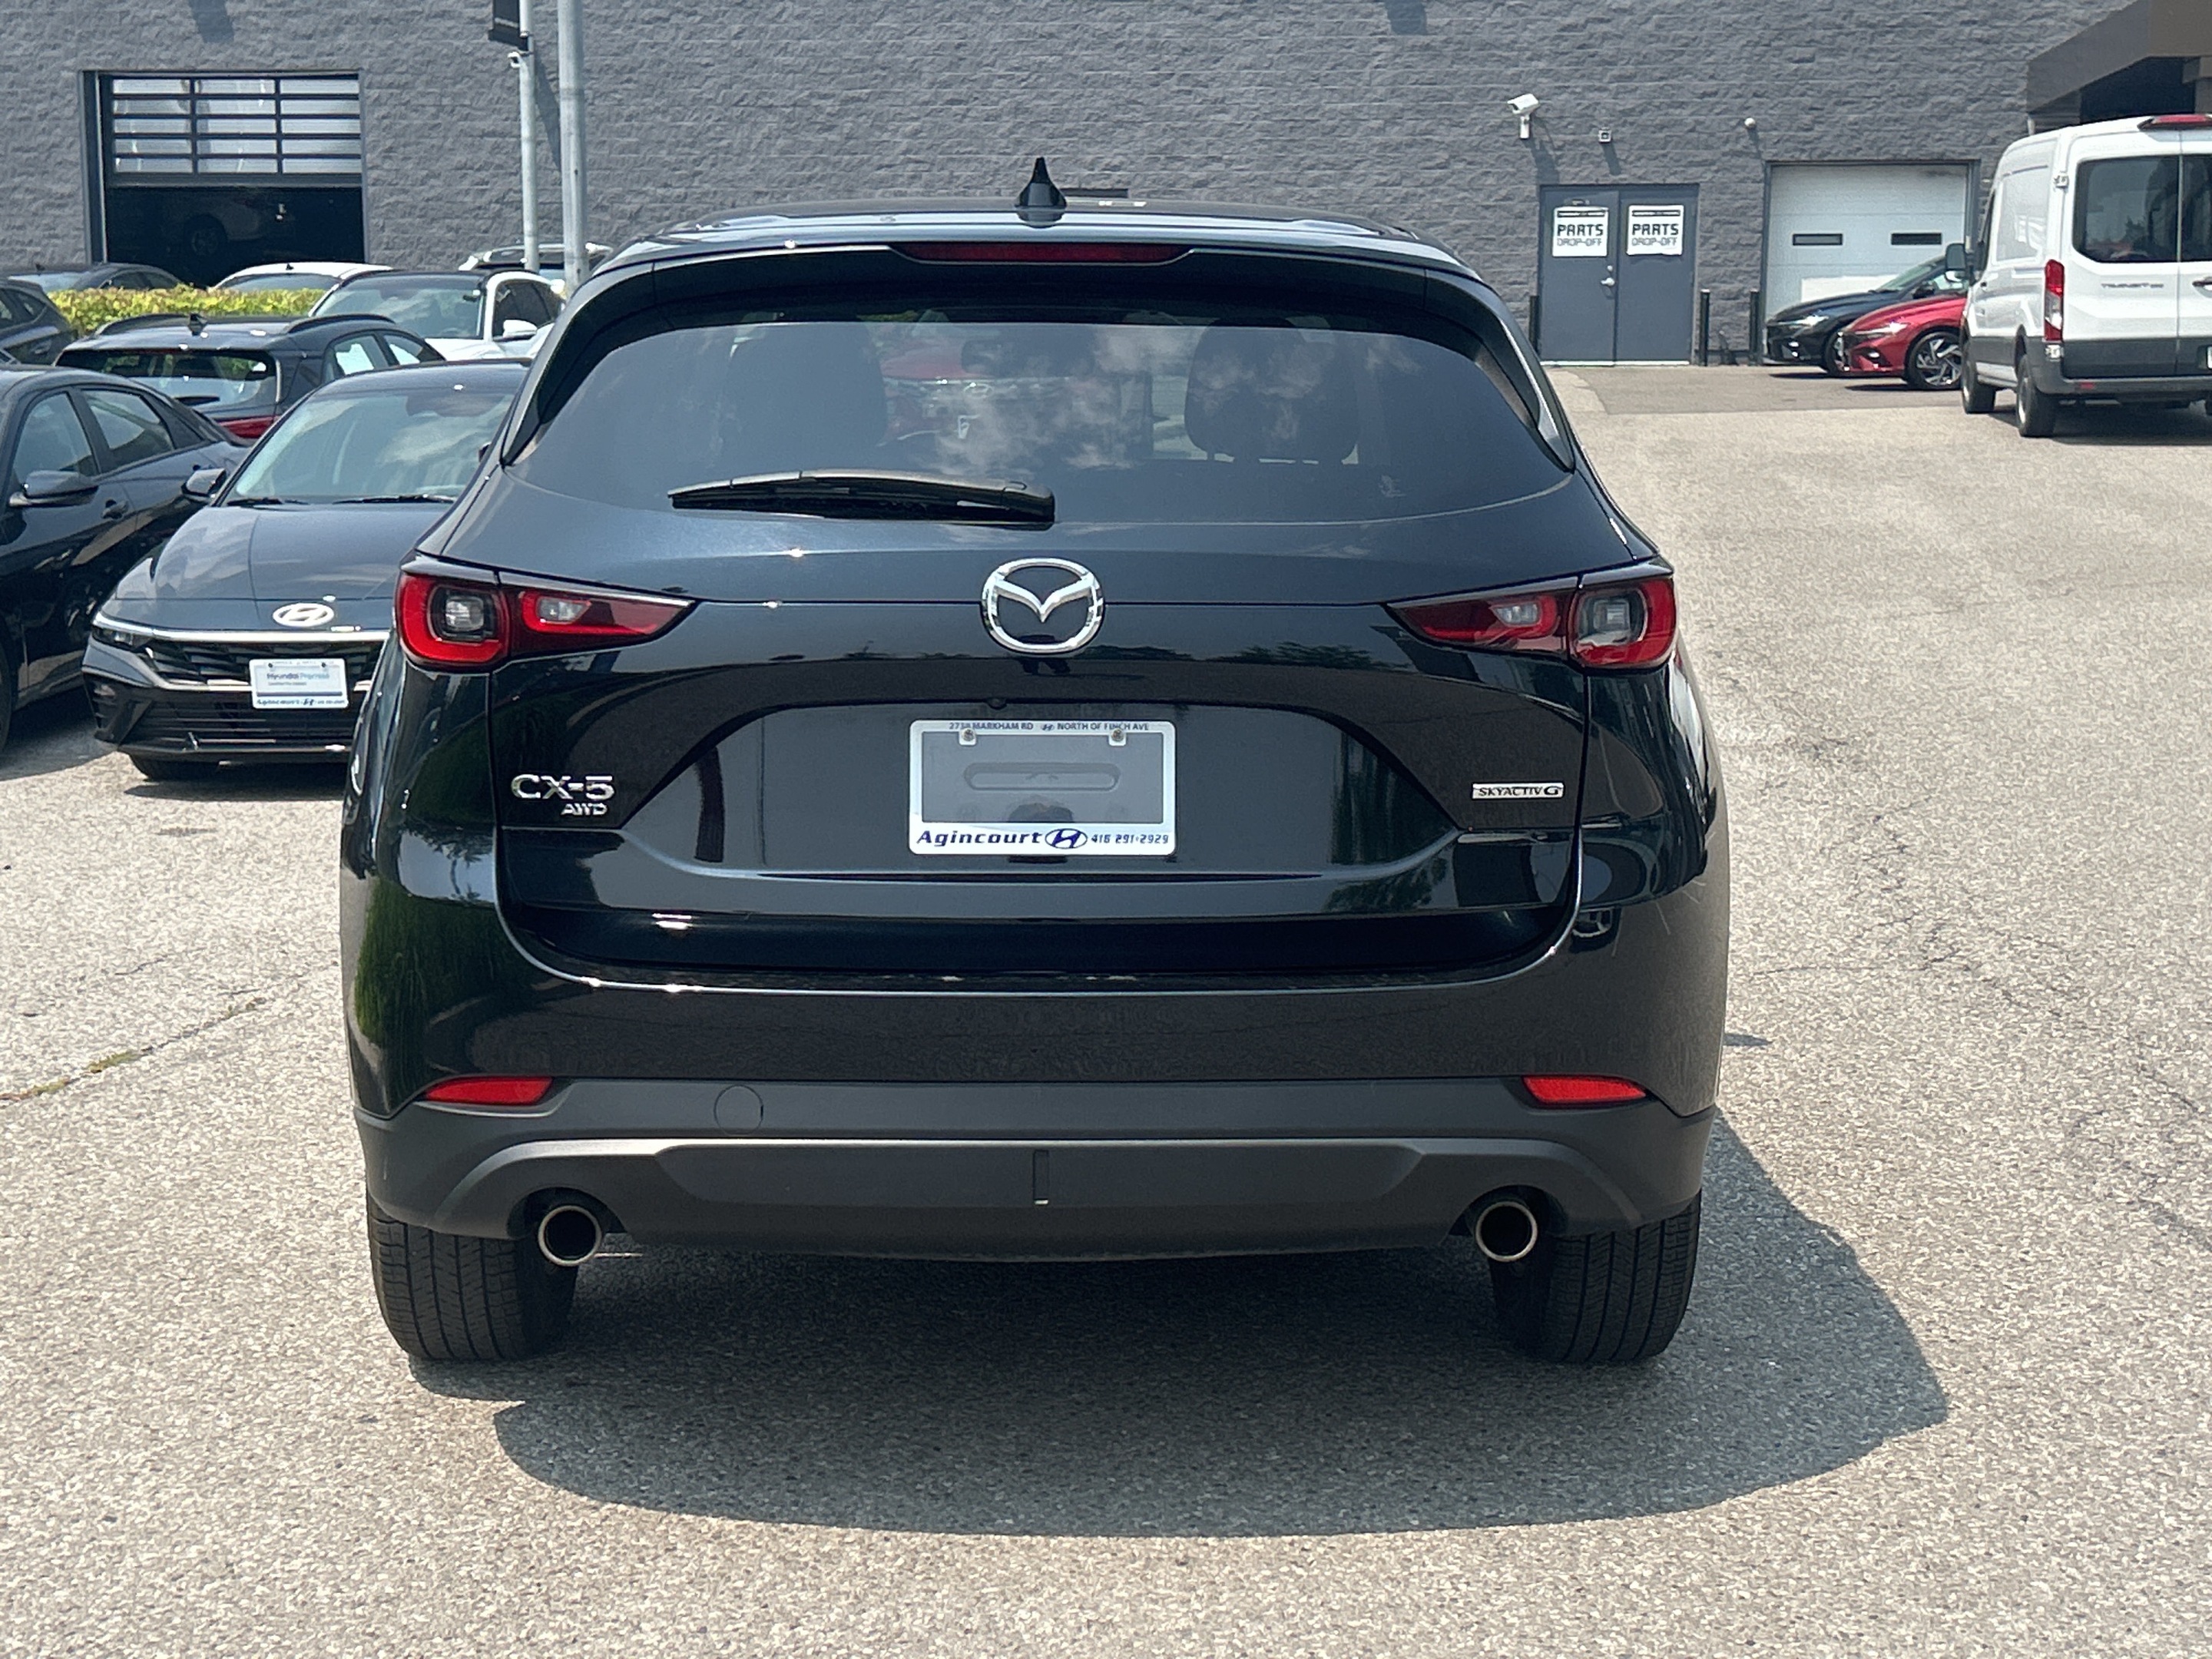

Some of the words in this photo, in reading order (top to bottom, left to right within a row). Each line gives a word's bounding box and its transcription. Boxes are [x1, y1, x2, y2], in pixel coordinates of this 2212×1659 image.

[1557, 224, 1604, 237] PARTS
[1632, 224, 1680, 236] PARTS
[1556, 237, 1602, 247] DROP-OFF
[1631, 237, 1677, 247] DROP-OFF
[1057, 722, 1088, 730] NORTH
[1090, 722, 1101, 730] OF
[1132, 723, 1149, 731] AVE
[511, 773, 614, 800] CX-5
[560, 803, 608, 816] AWD
[916, 830, 1042, 846] Agincourt
